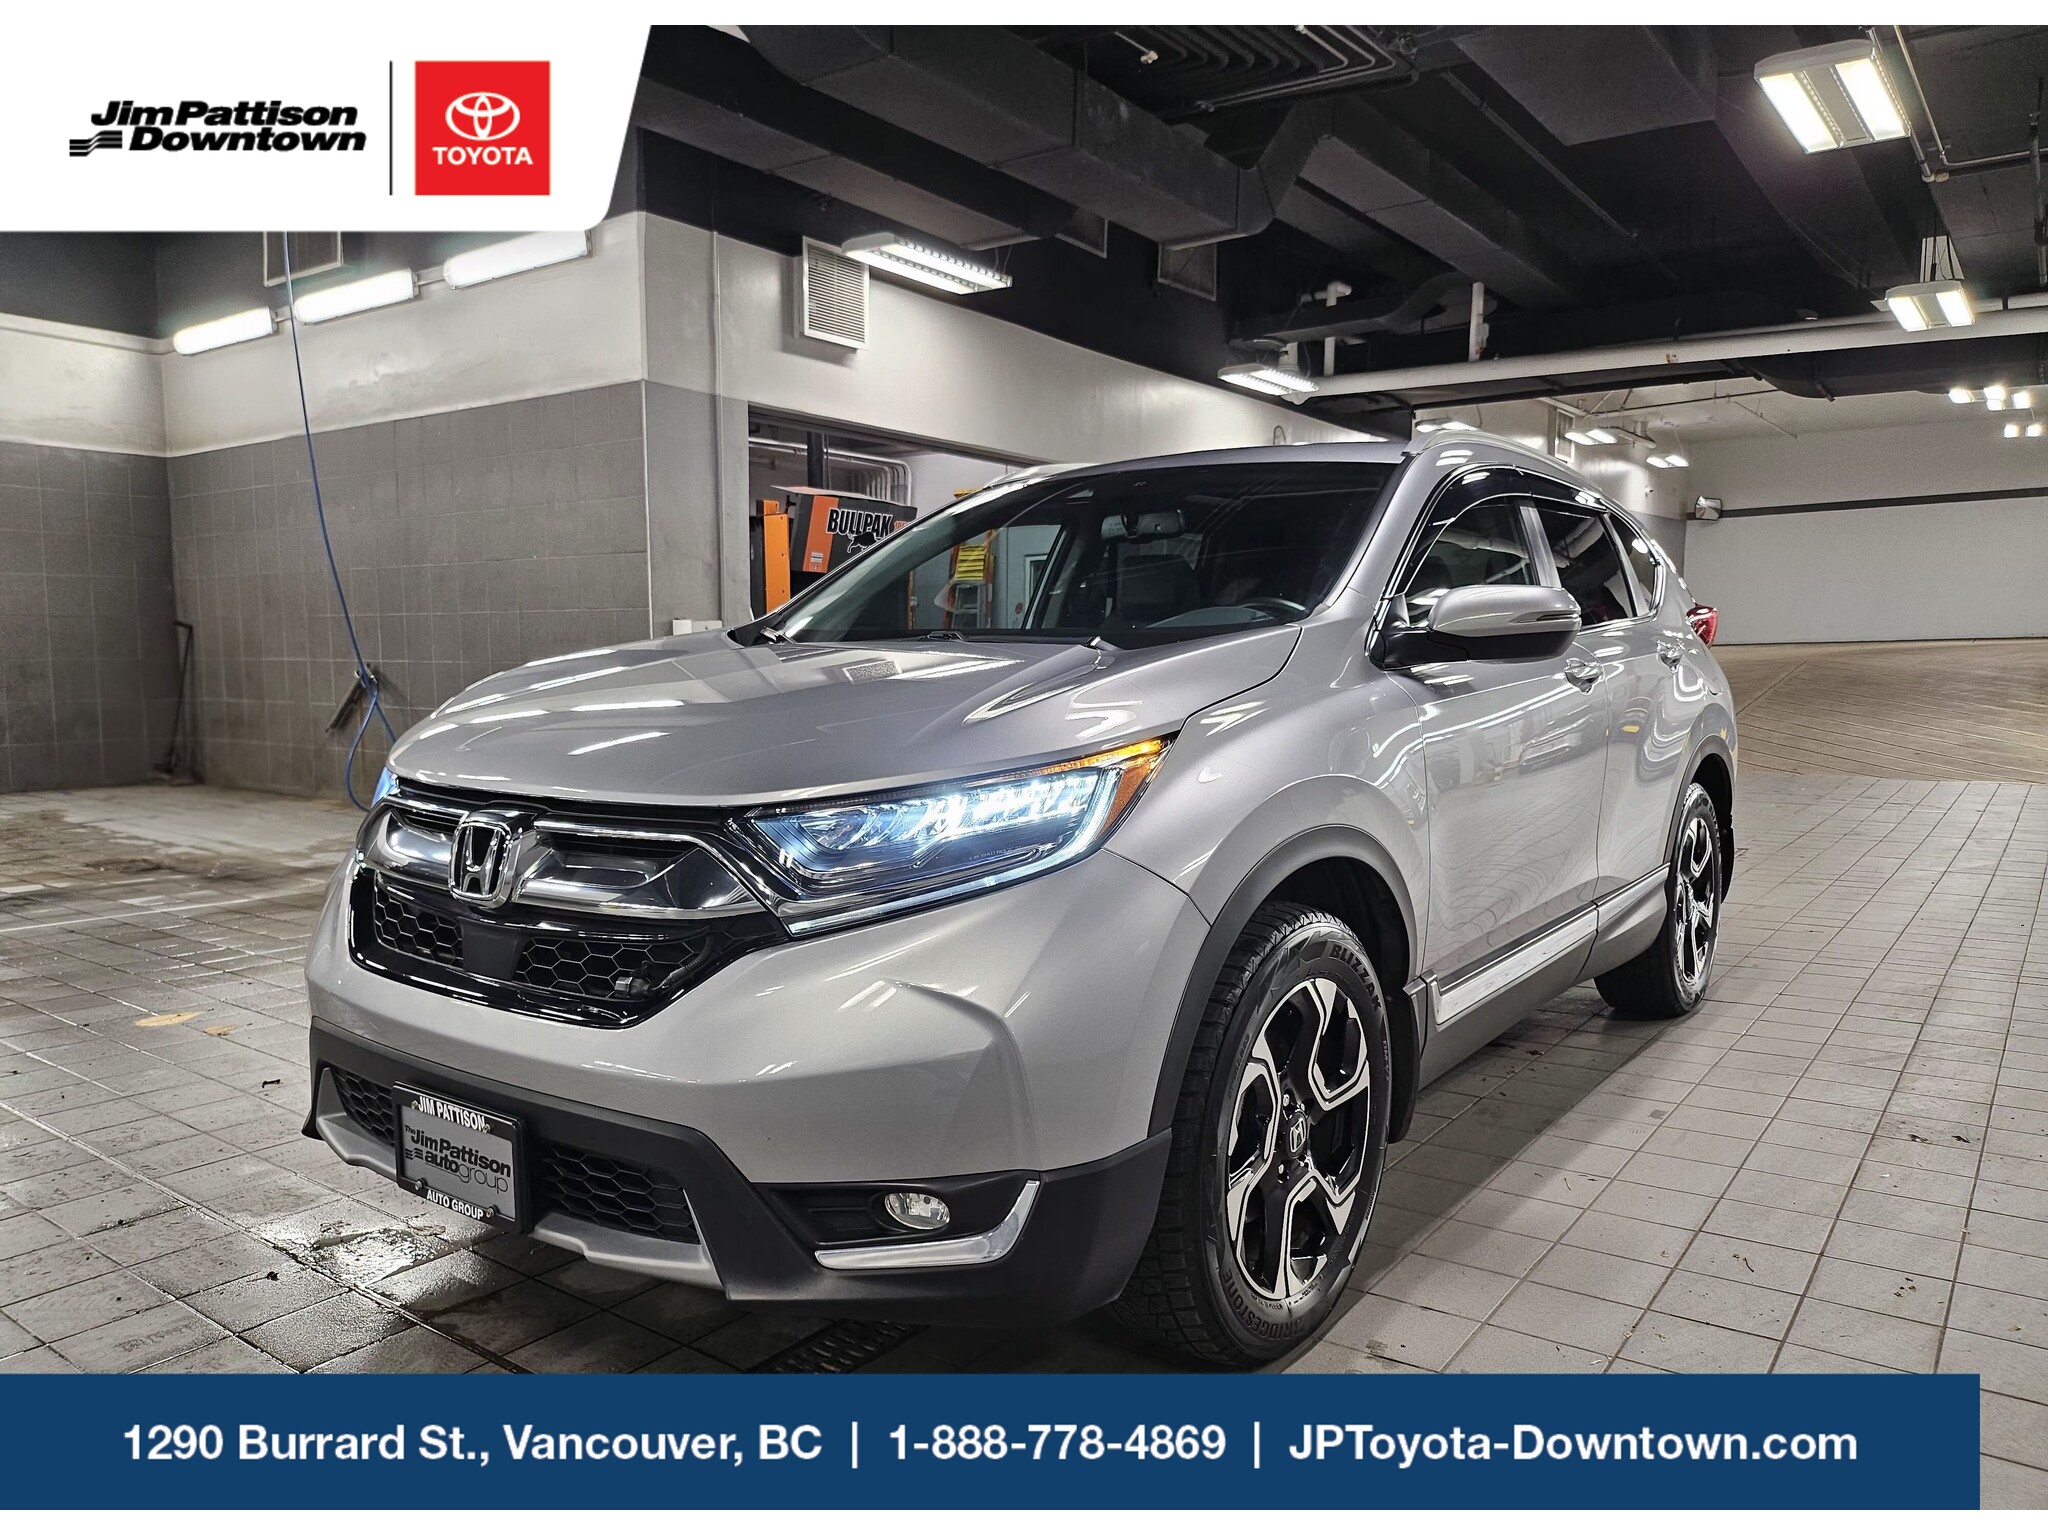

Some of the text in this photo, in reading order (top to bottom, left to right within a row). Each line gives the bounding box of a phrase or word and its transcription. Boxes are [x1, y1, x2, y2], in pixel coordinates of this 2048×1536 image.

[826, 508, 893, 540] BULLPAK
[1329, 943, 1382, 1013] BLIZZAK
[418, 1096, 486, 1131] JIM PATTISON
[404, 1125, 416, 1135] The
[426, 1189, 484, 1220] AUTO GROUP
